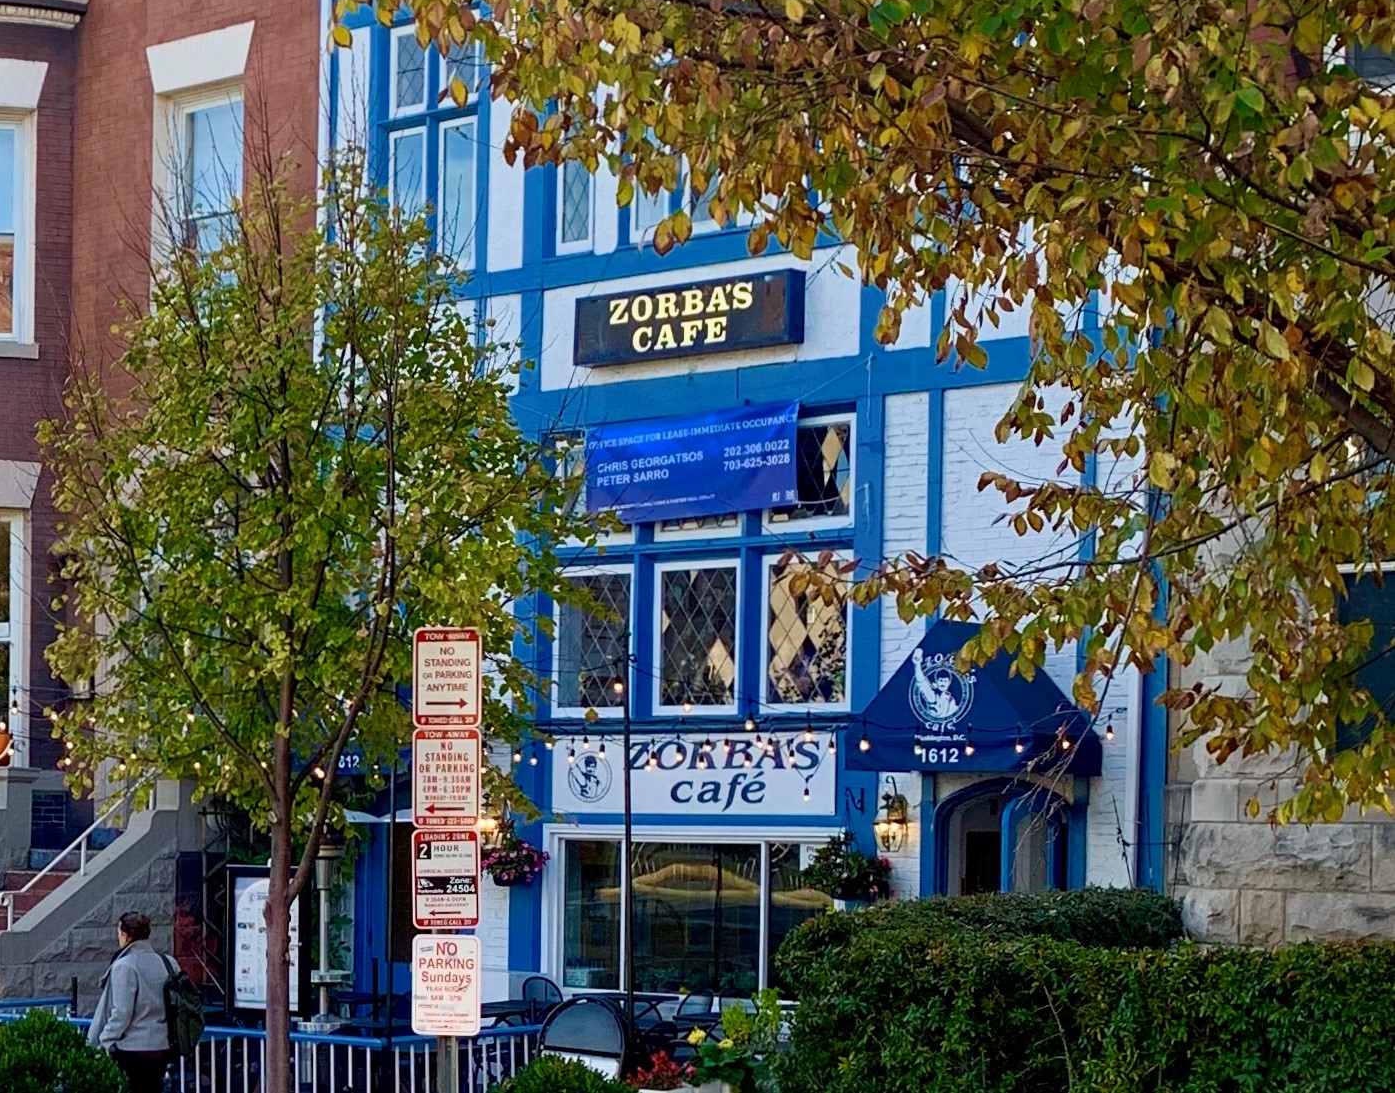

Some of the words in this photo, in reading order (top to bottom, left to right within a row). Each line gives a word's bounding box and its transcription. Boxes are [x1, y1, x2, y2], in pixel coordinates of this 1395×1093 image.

[609, 281, 754, 325] ZORBA'S
[631, 316, 728, 353] CAFE
[618, 435, 644, 447] SPACE
[645, 432, 662, 444] FOR
[742, 413, 797, 430] OCCUPANCY
[596, 458, 629, 474] CHRIS
[630, 450, 704, 471] GEORGATSOS
[723, 439, 790, 458] 202.306.0022
[596, 472, 631, 487] PETER
[632, 468, 670, 483] SARRO
[723, 453, 791, 471] 703-625-3028
[440, 647, 455, 655] NO
[424, 658, 471, 667] STANDING
[435, 671, 473, 679] PARKING
[426, 683, 468, 692] ANYTIME
[440, 741, 454, 751] NO
[338, 754, 360, 768] 612
[425, 752, 469, 762] STANDING
[629, 739, 821, 771] ZORBA'S
[921, 748, 959, 763] 1612
[419, 763, 431, 773] OR
[435, 763, 475, 773] PARKING
[669, 771, 768, 812] café
[452, 832, 470, 840] ZONE
[419, 843, 428, 859] 2
[433, 844, 460, 852] HOUR
[449, 876, 473, 884] Zone:
[446, 884, 476, 894] 24504
[436, 941, 458, 956] NO
[419, 958, 475, 970] PARKING
[421, 970, 472, 987] Sundays
